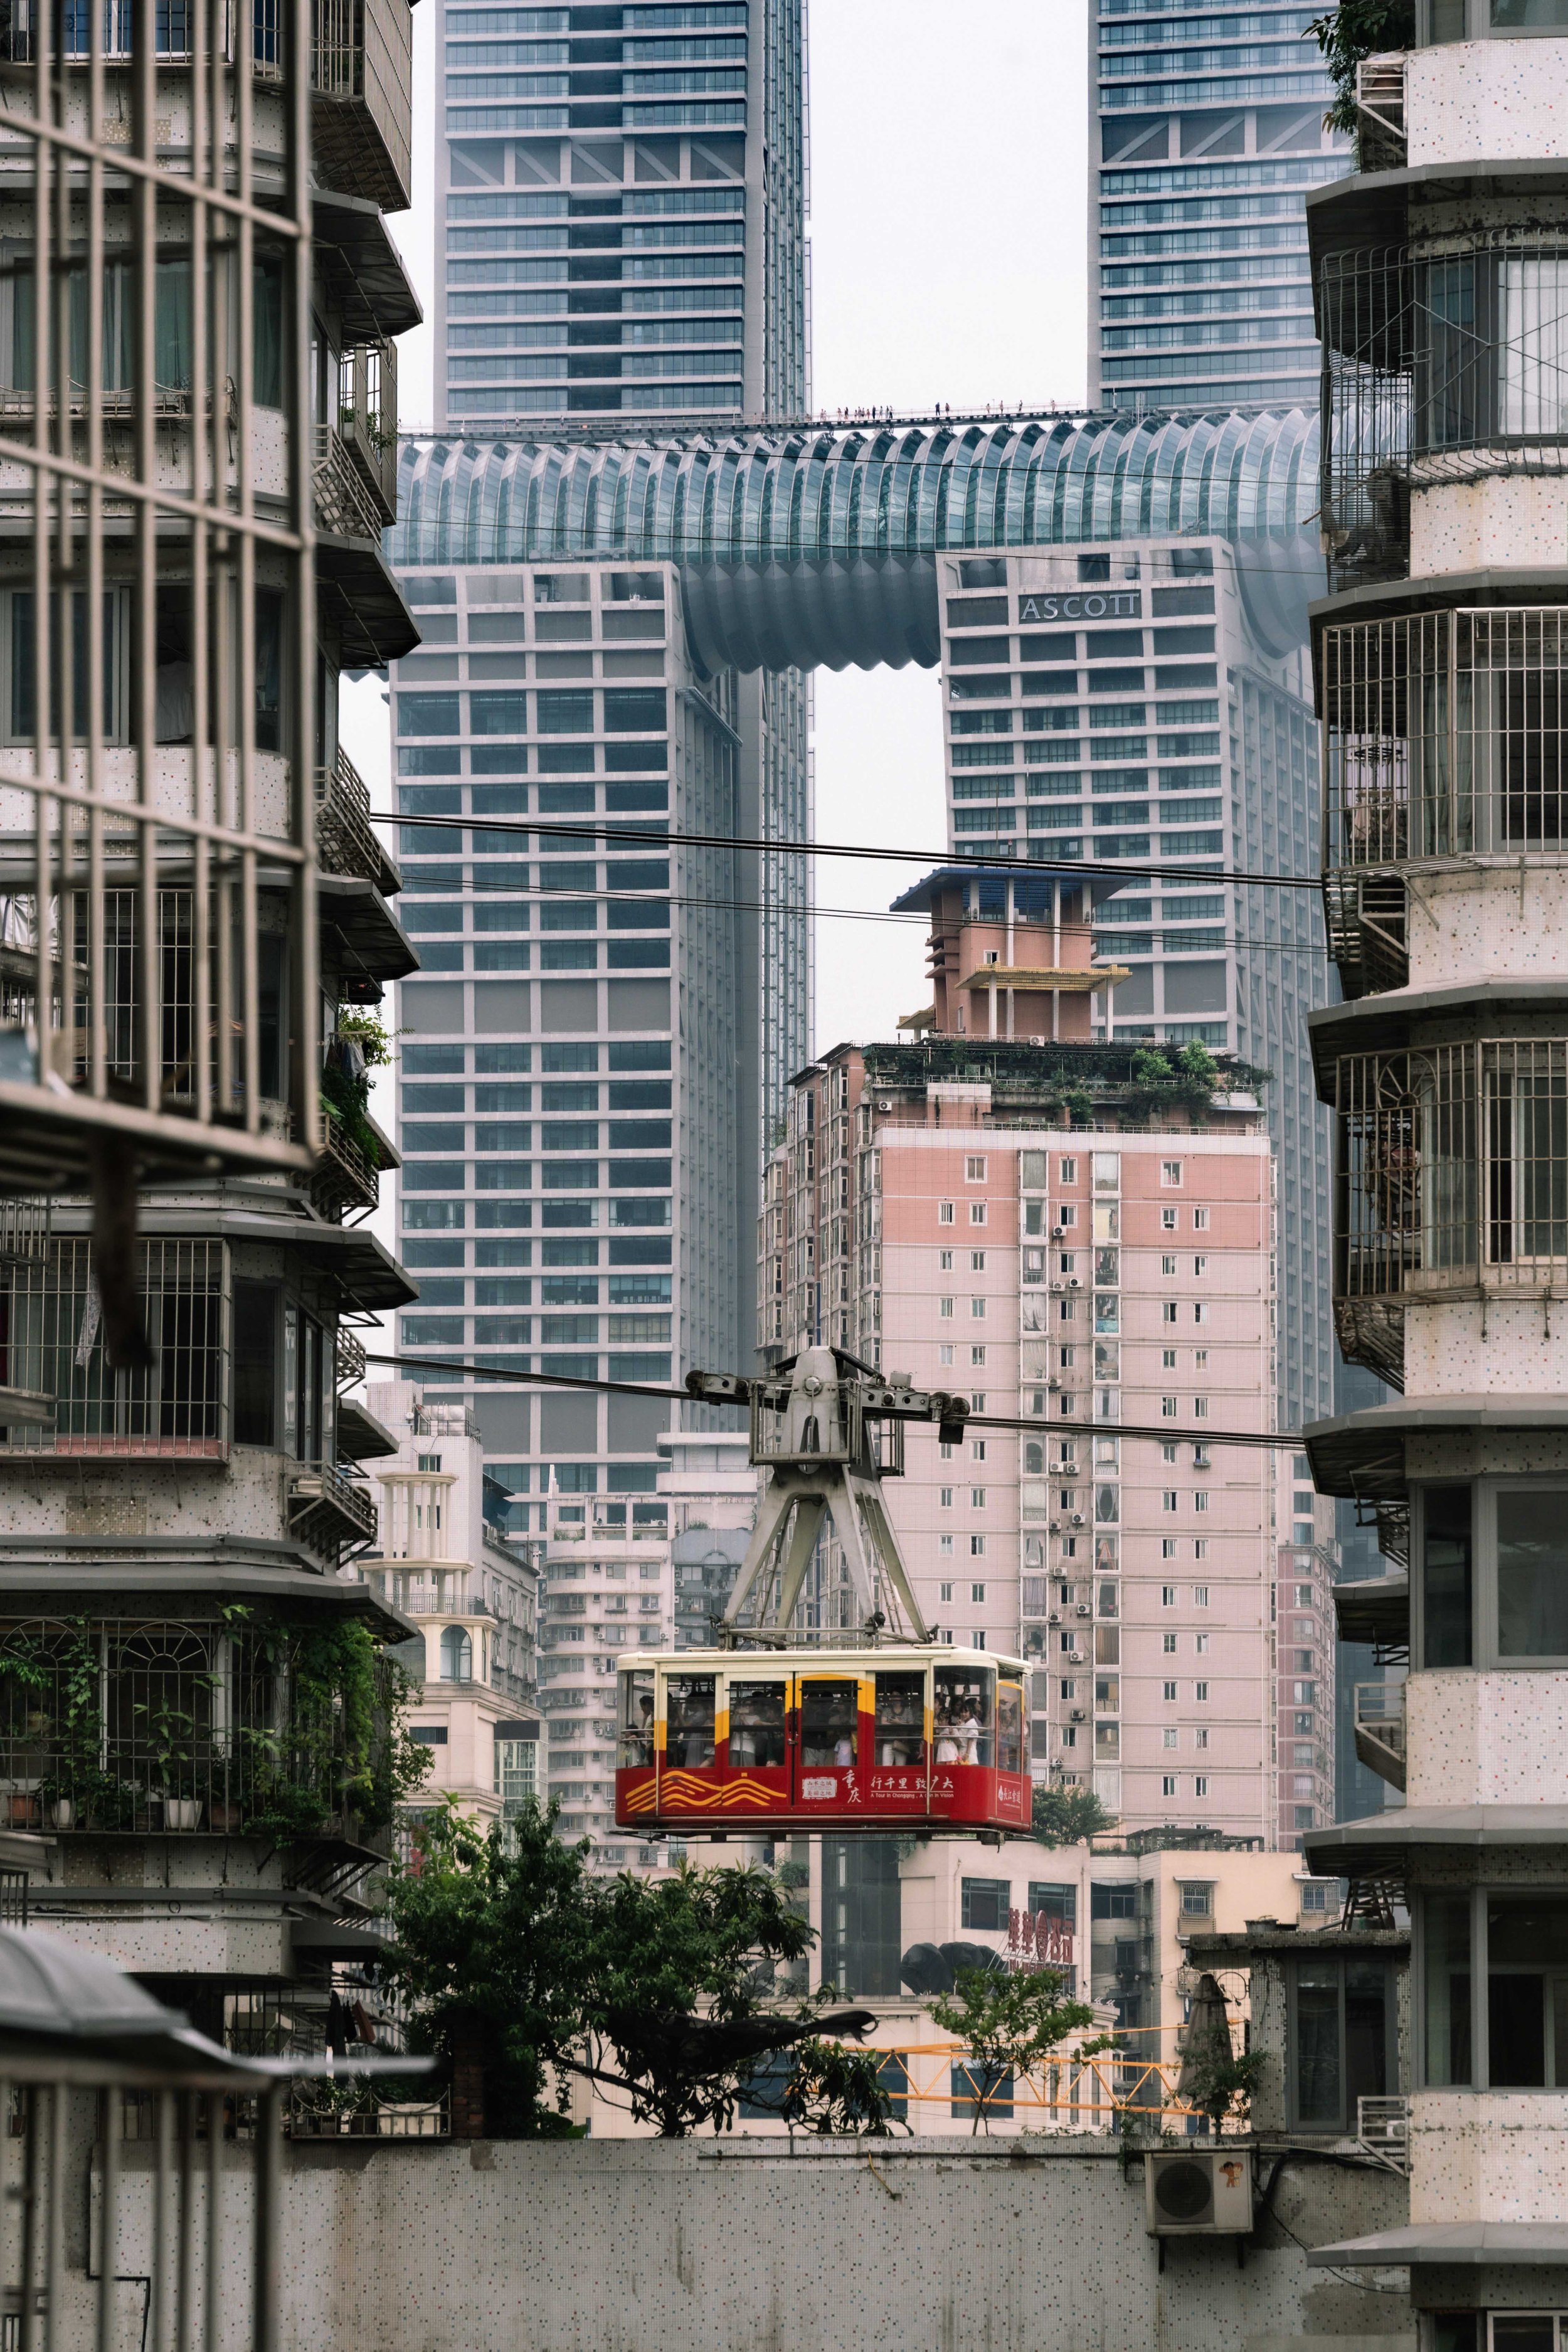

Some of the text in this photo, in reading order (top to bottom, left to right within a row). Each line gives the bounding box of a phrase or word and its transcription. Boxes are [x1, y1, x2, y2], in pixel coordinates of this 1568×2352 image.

[1020, 593, 1139, 619] ASCOTT
[842, 1769, 862, 1803] 重庆
[871, 1776, 907, 1789] 行千里
